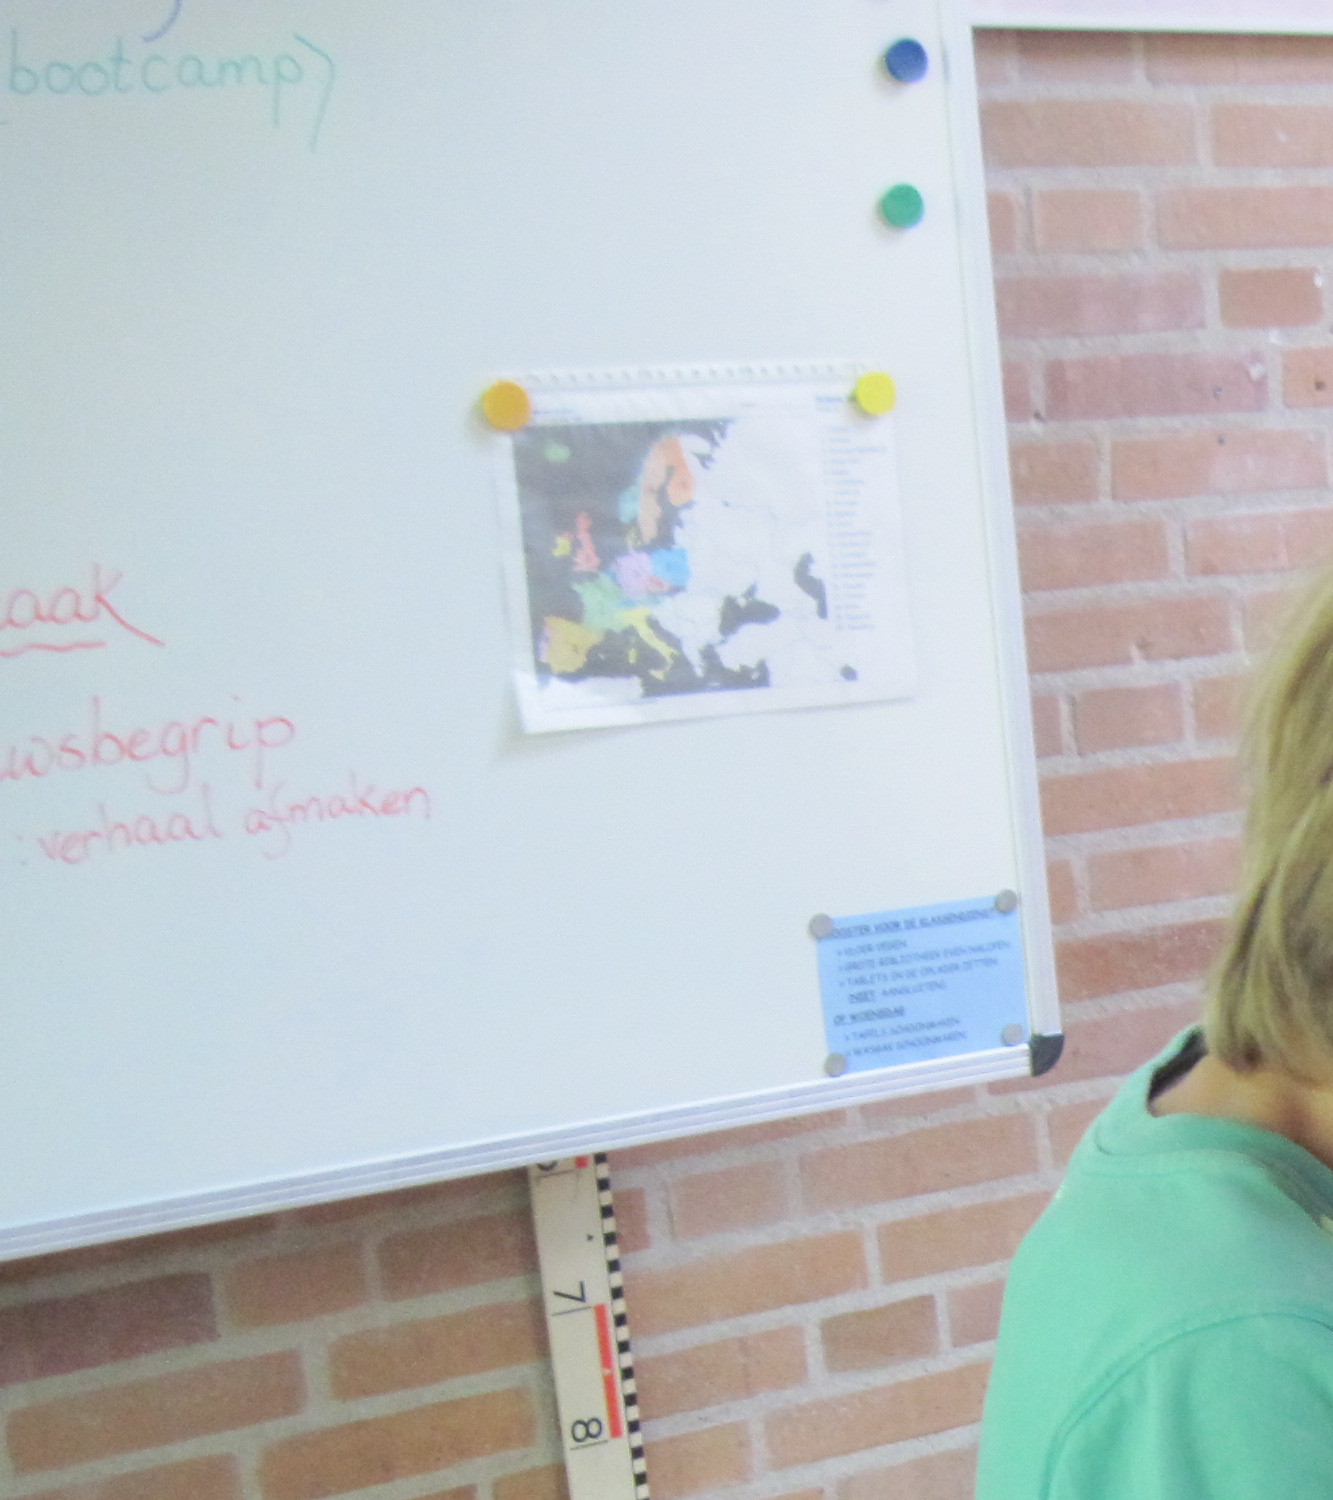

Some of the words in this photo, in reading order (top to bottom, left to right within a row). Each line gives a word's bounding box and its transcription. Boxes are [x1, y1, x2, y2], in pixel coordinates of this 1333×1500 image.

[0, 562, 166, 646] aak
[553, 1280, 589, 1306] 7
[570, 1416, 603, 1444] 8
